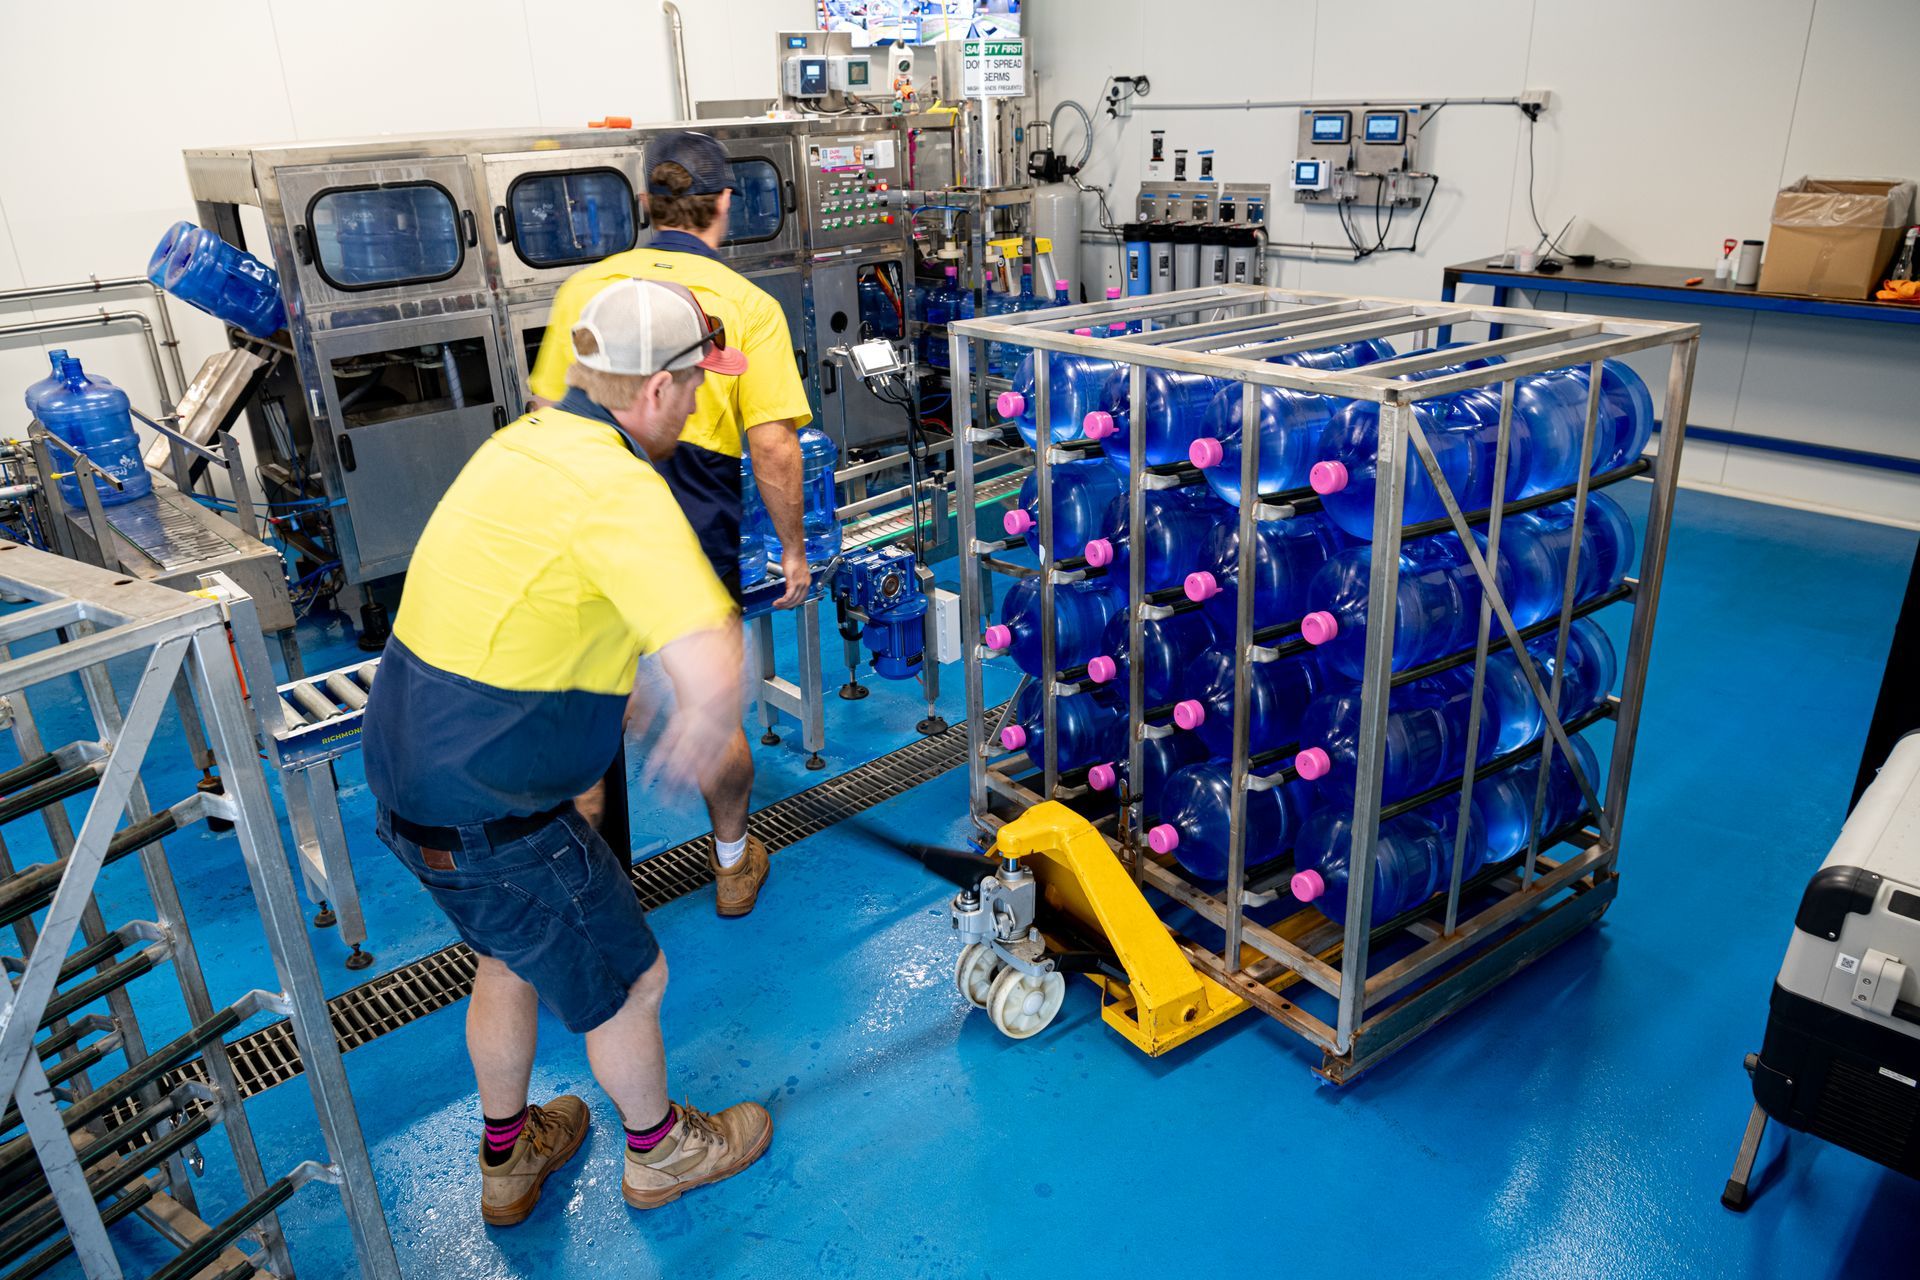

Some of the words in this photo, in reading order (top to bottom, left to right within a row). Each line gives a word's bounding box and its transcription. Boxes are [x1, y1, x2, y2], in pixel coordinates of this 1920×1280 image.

[966, 44, 1001, 54] SAETY
[1001, 44, 1022, 54] FIRST
[966, 60, 991, 69] DOT
[993, 59, 1022, 69] SPREAD
[322, 727, 362, 744] RICHMON
